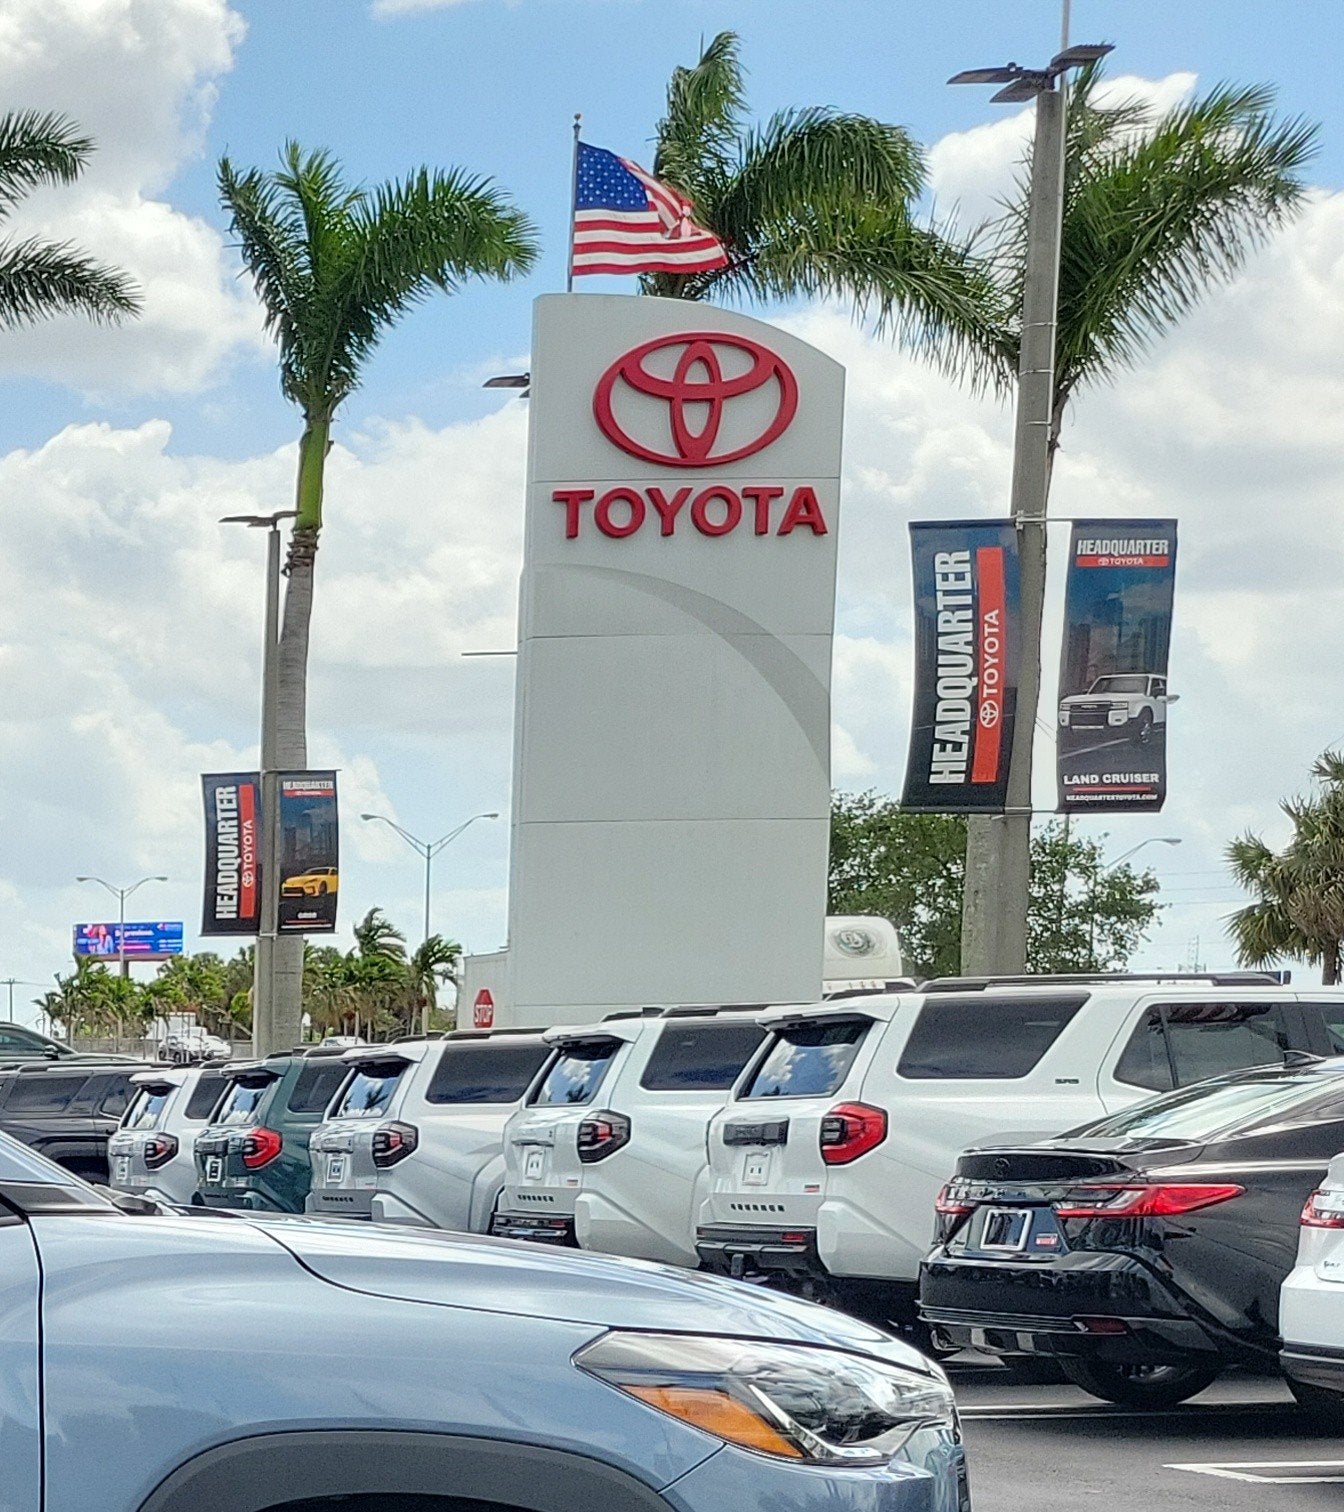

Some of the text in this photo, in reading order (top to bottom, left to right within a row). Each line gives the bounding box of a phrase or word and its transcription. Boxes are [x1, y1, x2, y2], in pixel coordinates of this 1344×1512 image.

[551, 485, 829, 539] TOYOTA
[1076, 539, 1169, 557] HEADQUARTER
[1110, 557, 1144, 565] TOYOTA
[928, 549, 979, 784] HEADQUARTER
[983, 608, 1000, 698] TOYOTA
[1063, 773, 1160, 784] LAND CRUISER
[215, 785, 241, 919] HEADQUARTER
[243, 819, 254, 871] TOYOTA
[475, 1004, 492, 1022] STOP
